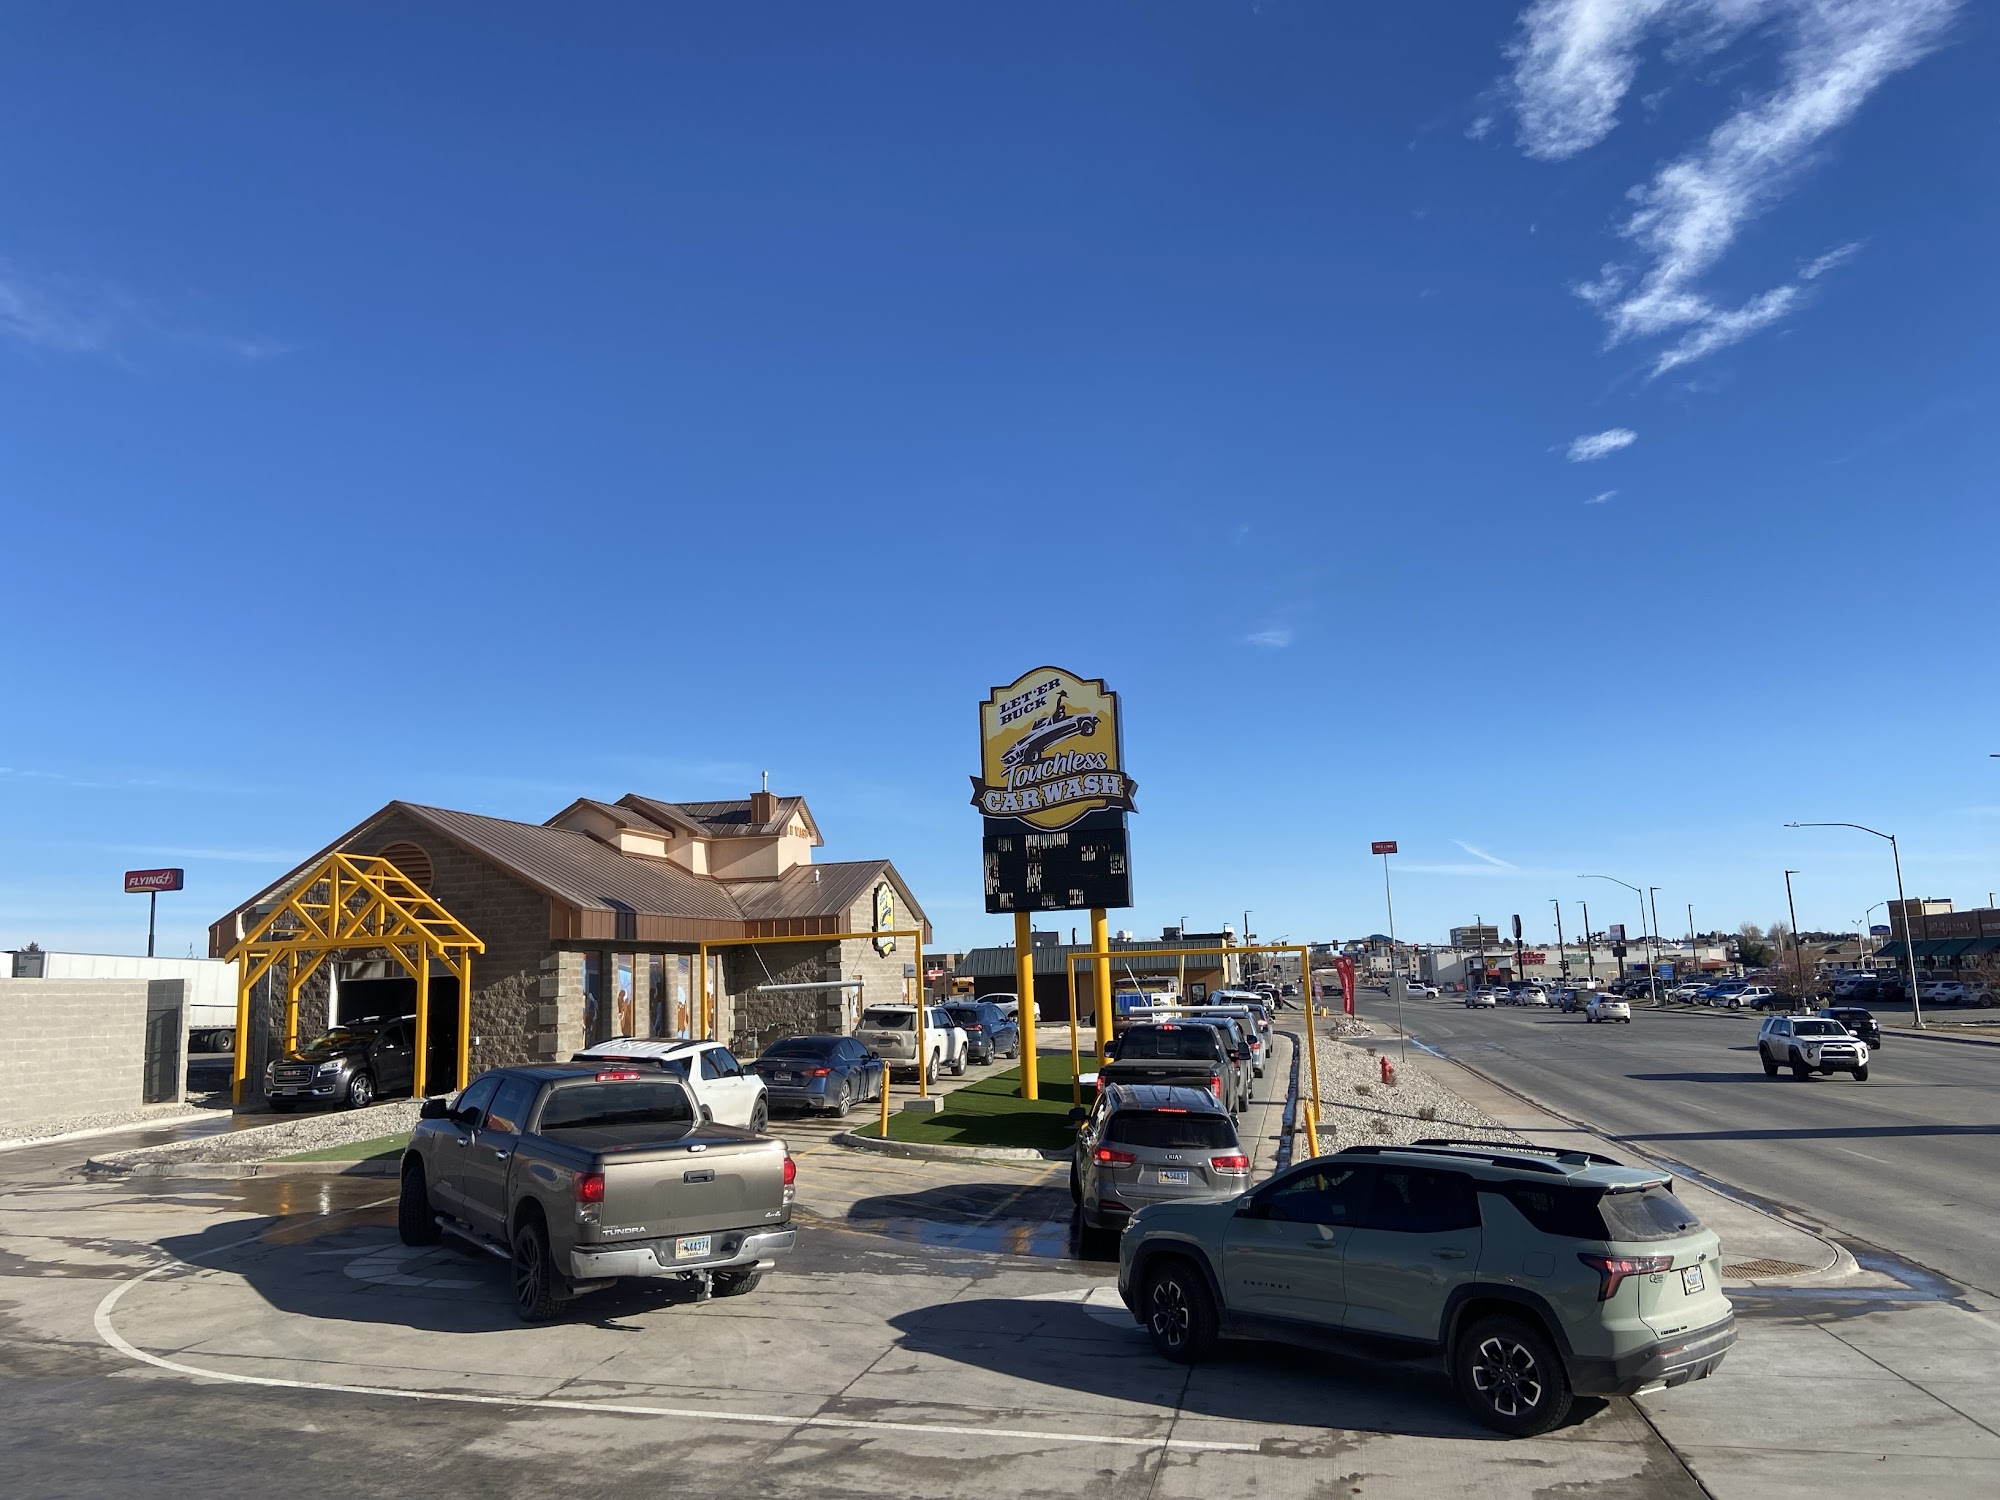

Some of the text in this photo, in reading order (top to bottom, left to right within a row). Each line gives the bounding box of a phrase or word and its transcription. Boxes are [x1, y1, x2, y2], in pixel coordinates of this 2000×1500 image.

[1000, 678, 1061, 715] LET'ER
[1000, 696, 1047, 726] BUCK
[1001, 750, 1108, 793] Touchless
[985, 775, 1121, 812] CAR WASH
[129, 876, 162, 886] FLYING
[602, 1226, 646, 1236] TUNDRA
